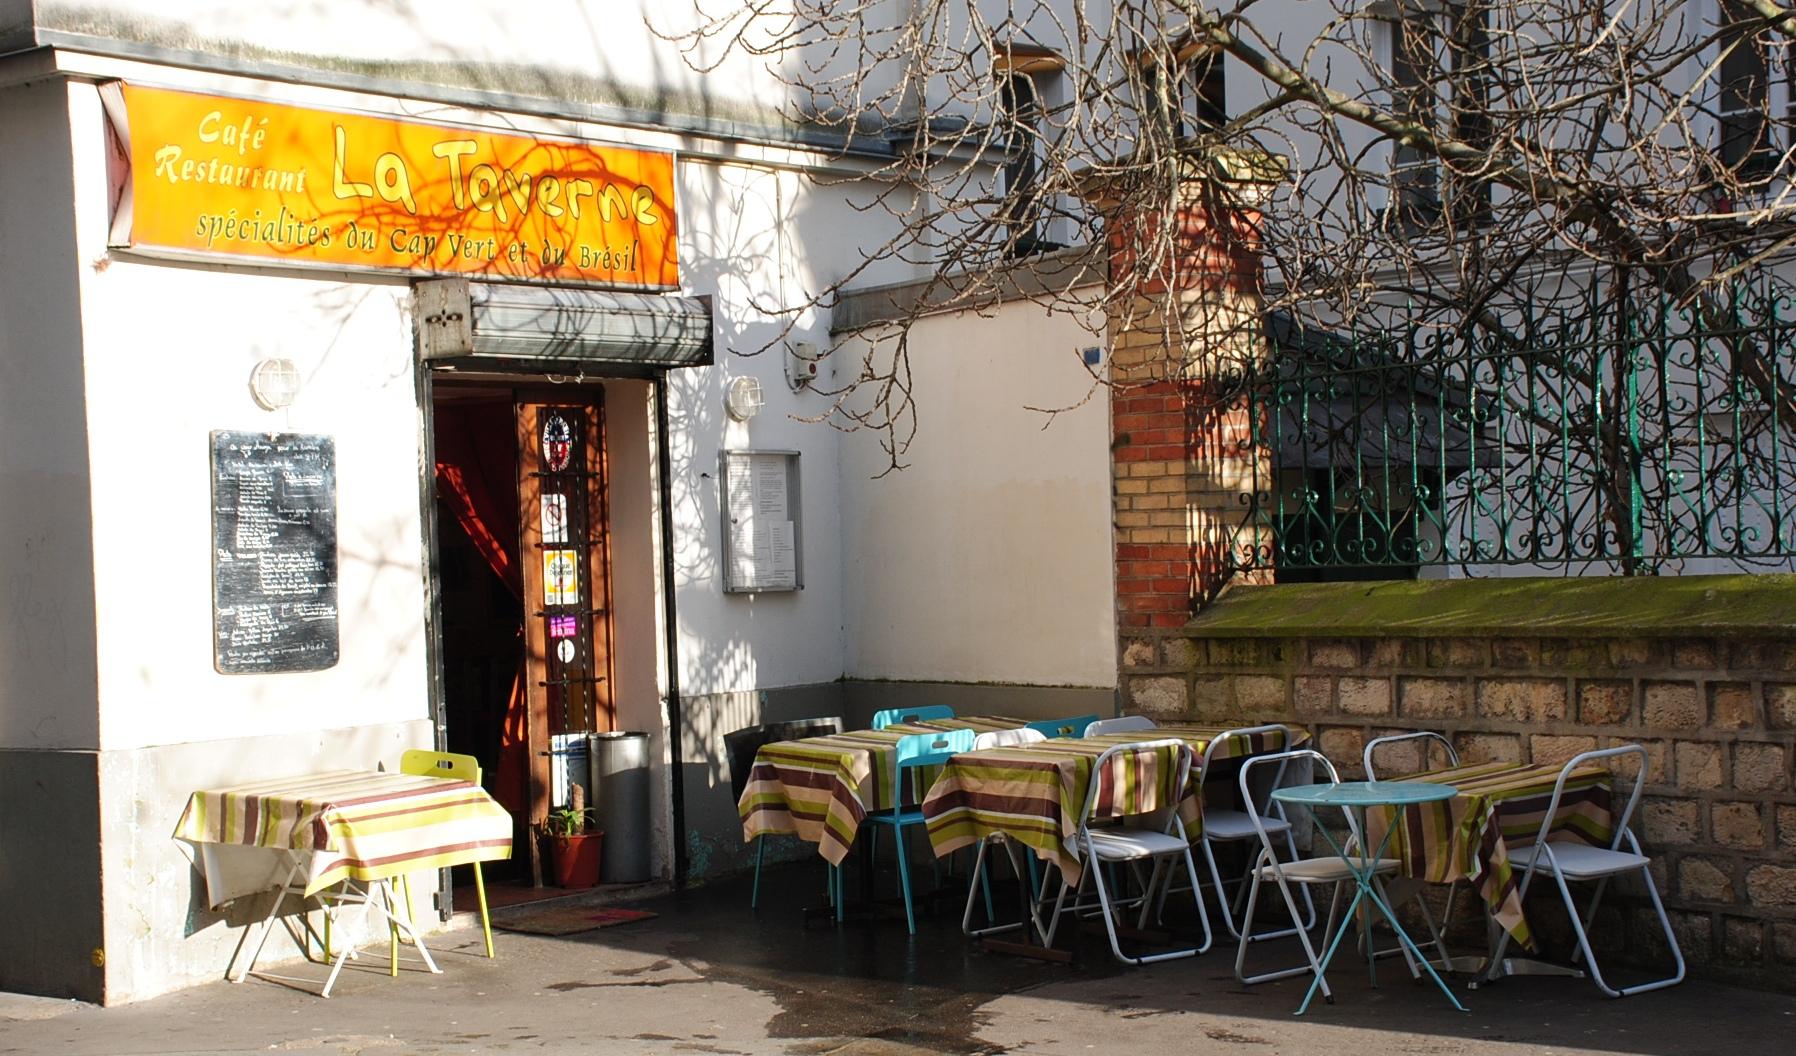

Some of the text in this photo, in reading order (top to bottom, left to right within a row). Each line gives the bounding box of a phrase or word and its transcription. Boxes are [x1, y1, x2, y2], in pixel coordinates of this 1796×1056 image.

[198, 110, 270, 156] Café
[154, 144, 307, 194] Restaurant
[332, 124, 658, 226] La Taverne
[196, 205, 639, 272] spécialités du Cap Vert et du Brésil
